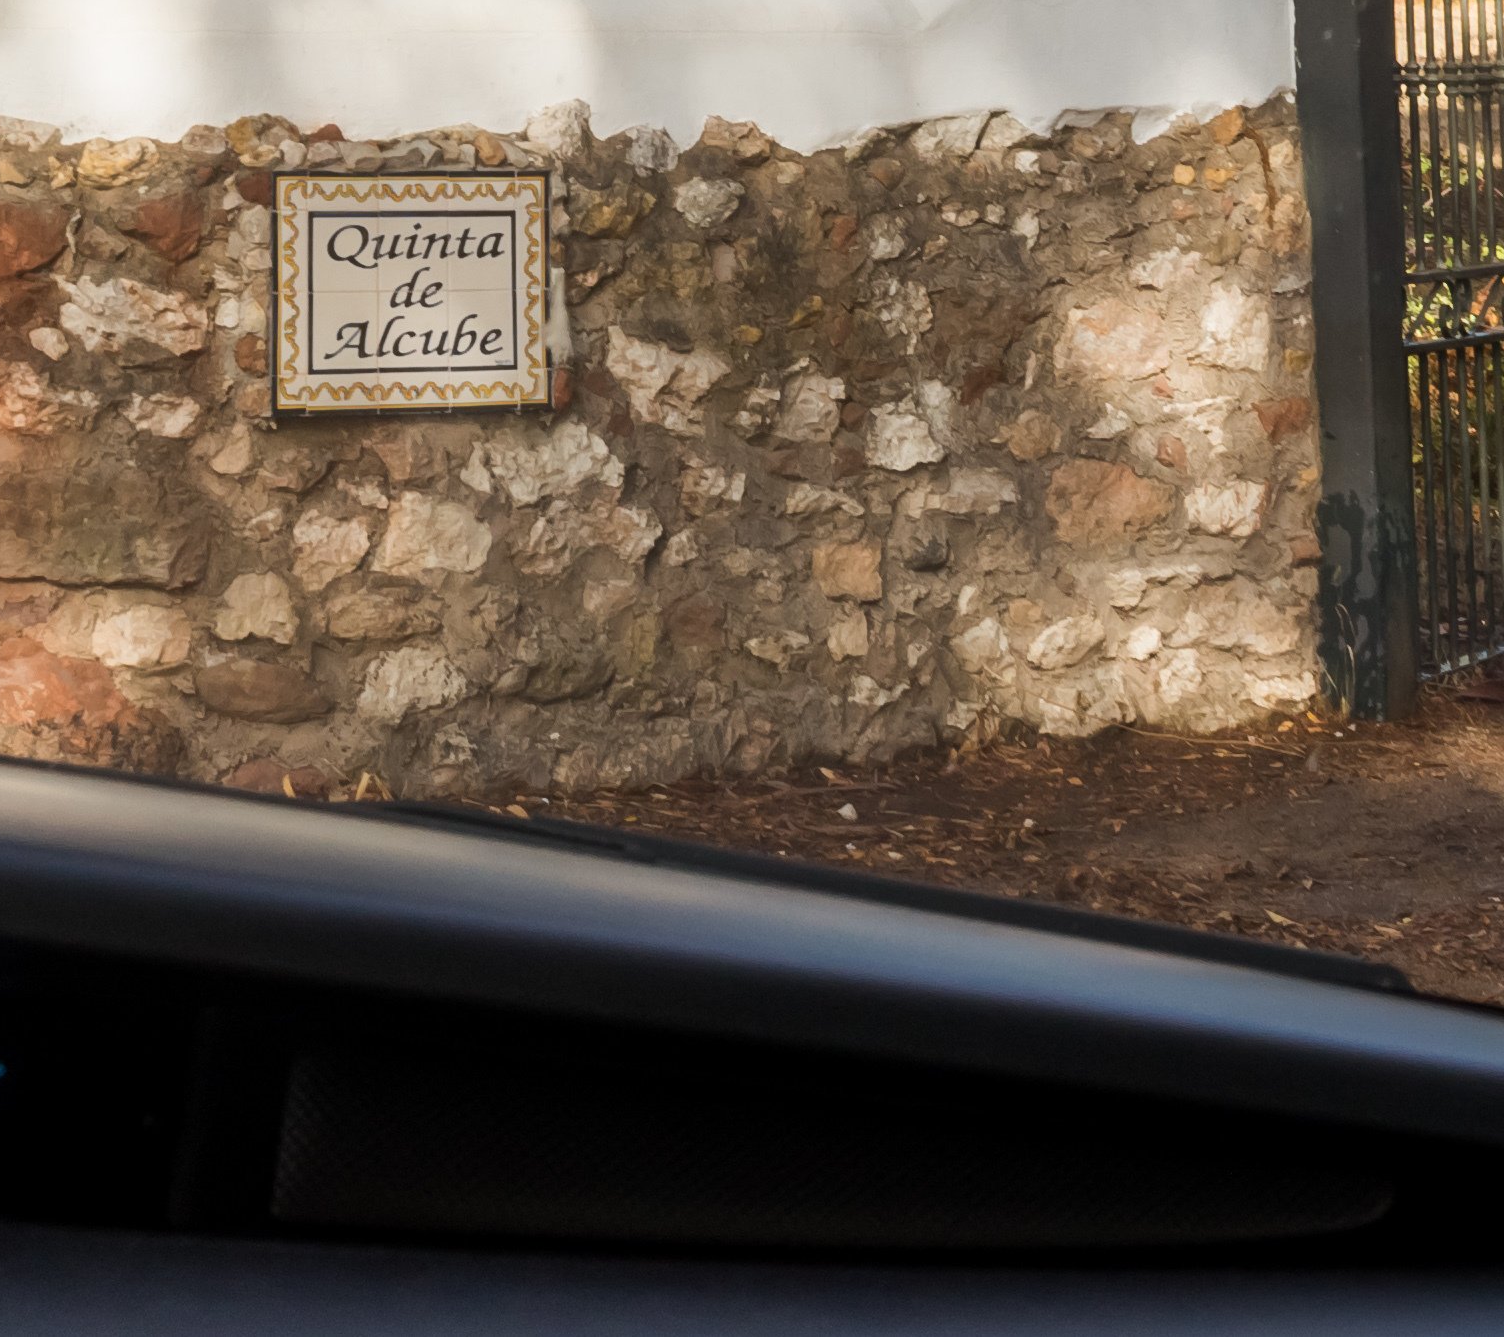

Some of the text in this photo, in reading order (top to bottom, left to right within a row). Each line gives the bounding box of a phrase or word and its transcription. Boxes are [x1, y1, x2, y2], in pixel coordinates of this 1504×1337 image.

[326, 222, 506, 270] Quinta
[390, 267, 443, 309] de
[324, 313, 504, 360] Alcube
